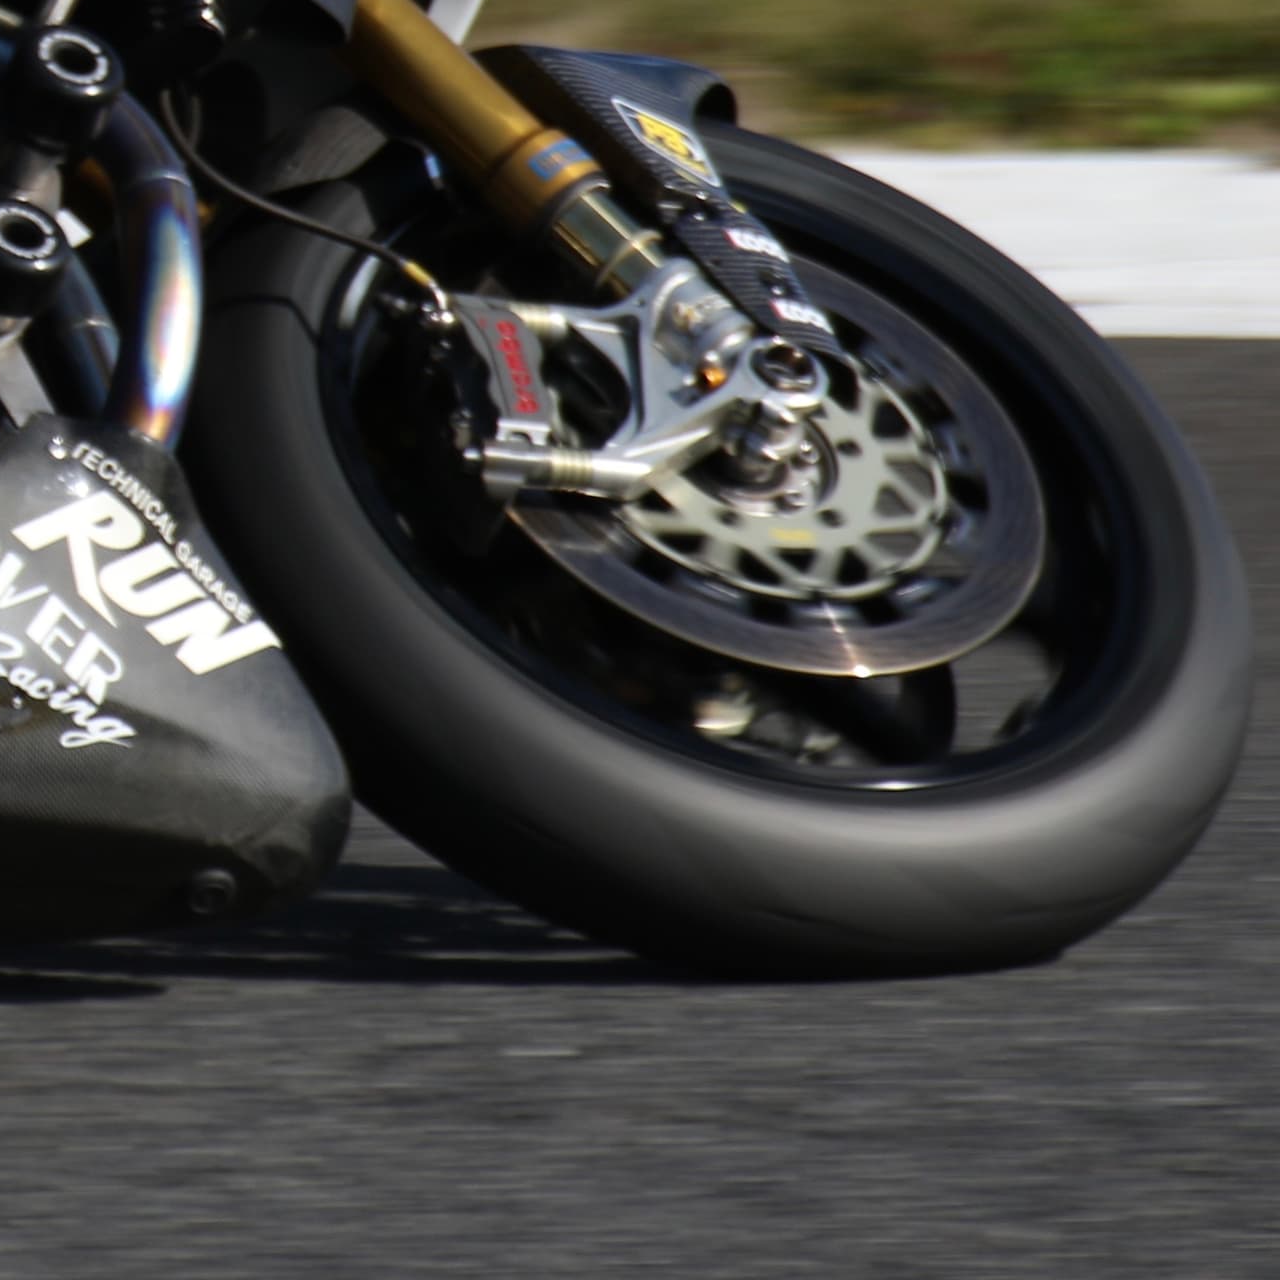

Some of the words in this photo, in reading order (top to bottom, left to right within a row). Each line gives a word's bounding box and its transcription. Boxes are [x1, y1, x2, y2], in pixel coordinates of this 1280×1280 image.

[12, 490, 283, 676] RUN
[72, 441, 177, 545] TECHNICAL
[175, 541, 257, 625] GARAGE
